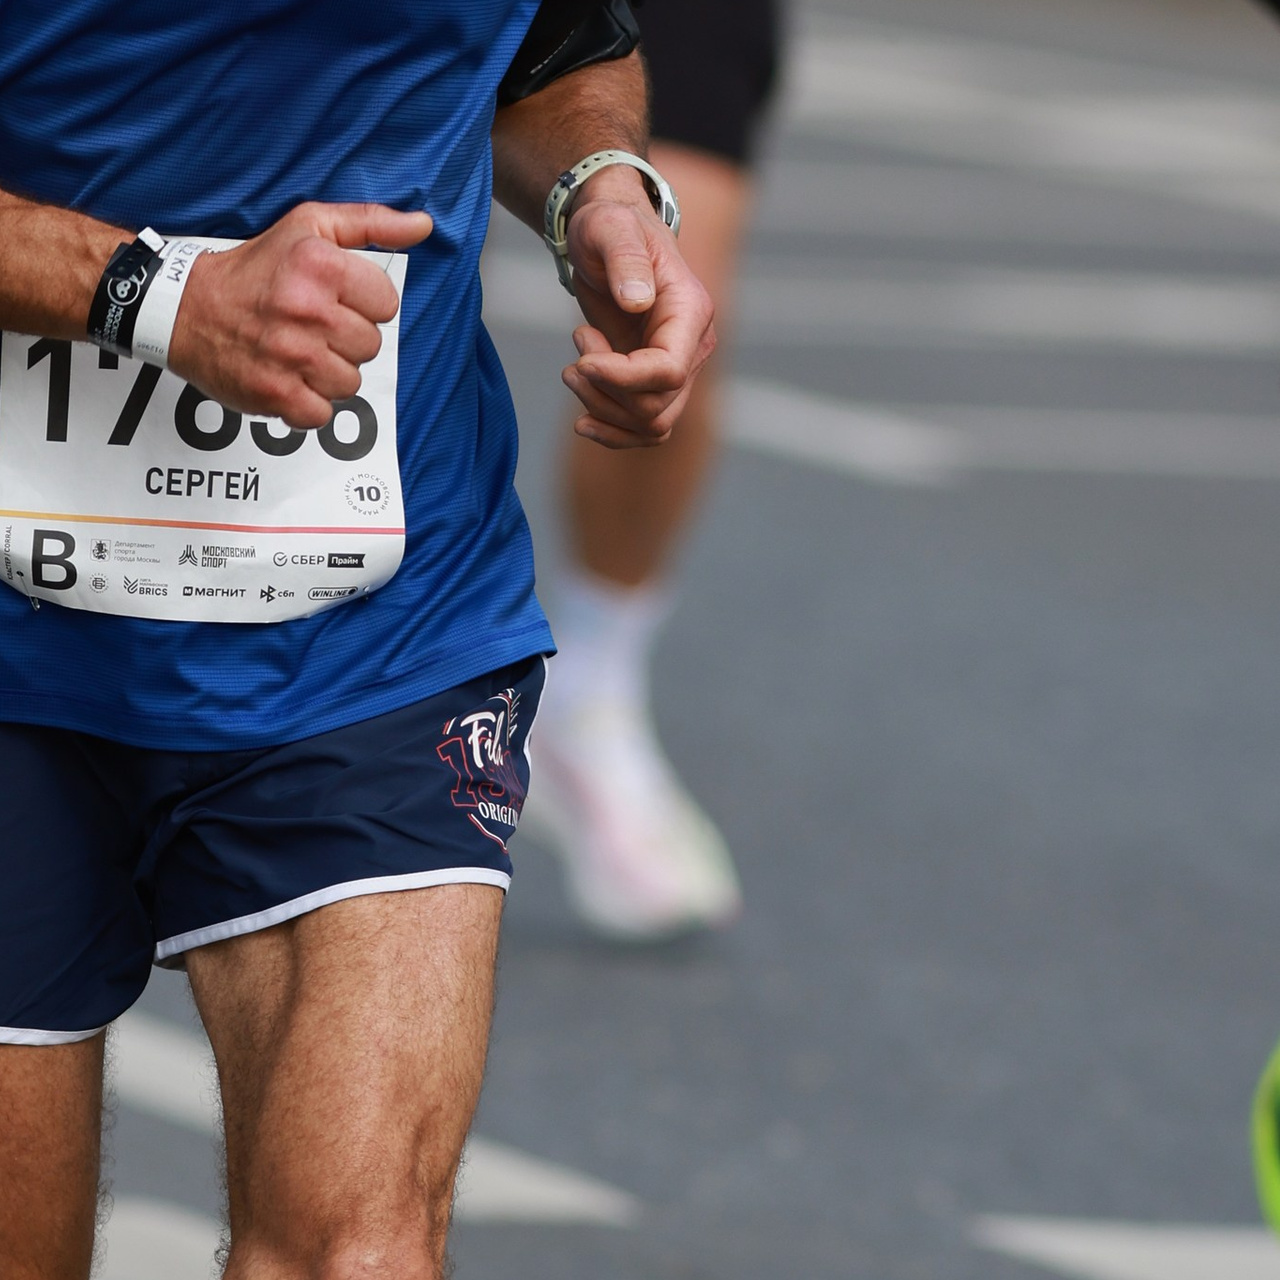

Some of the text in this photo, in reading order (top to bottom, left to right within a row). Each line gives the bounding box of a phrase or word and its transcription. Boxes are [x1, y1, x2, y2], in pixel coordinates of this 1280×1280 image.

[145, 466, 260, 502] СЕРГЕЙ
[353, 486, 381, 502] 10
[3, 524, 13, 553] CORRAL
[201, 545, 256, 558] МОСКОВСКИЙ
[201, 556, 228, 568] СПОРТ
[291, 554, 359, 566] СБЕР Прайм
[138, 586, 169, 597] BRICS
[195, 587, 247, 598] магнит
[277, 590, 295, 598] сбп
[312, 589, 349, 598] WINLINE
